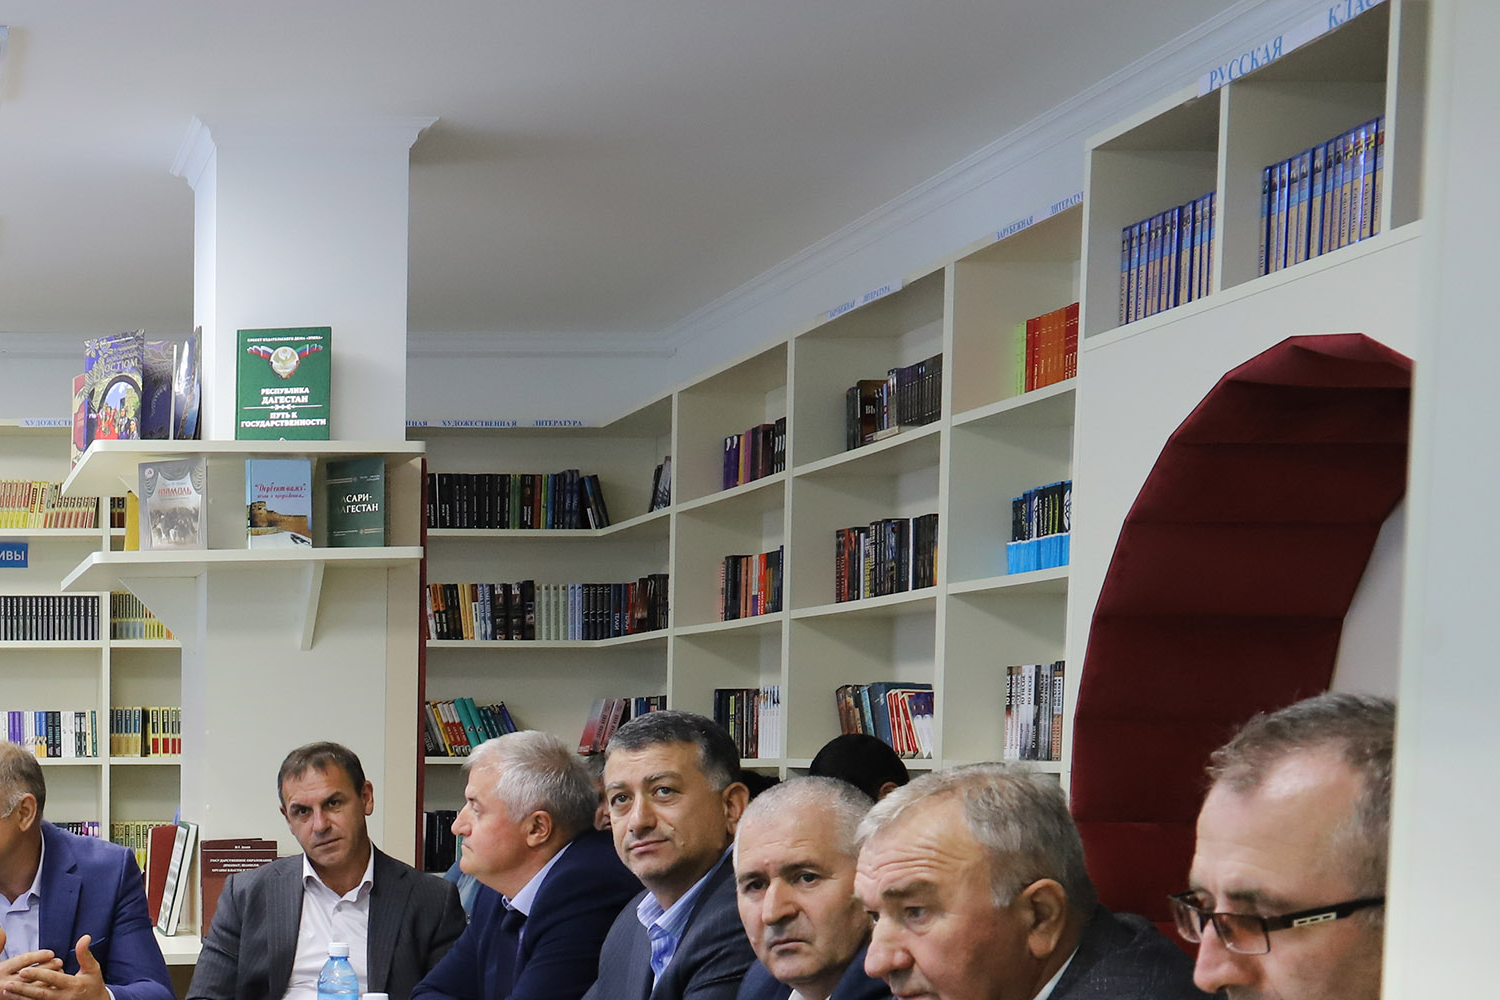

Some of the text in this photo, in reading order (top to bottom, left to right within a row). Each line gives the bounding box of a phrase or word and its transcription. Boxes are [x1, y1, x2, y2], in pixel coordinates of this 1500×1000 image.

[1209, 35, 1283, 92] РУССКАЯ
[996, 215, 1034, 240] ЗАРУБЕЖНАЯ
[101, 357, 139, 374] ОСТЮМ
[260, 387, 310, 396] РЕСПУБЛИКА
[261, 395, 309, 405] ДАГЕСТАН
[269, 411, 298, 420] ПУТЬ К
[240, 418, 327, 428] ГОСУДАРСТВЕННОСТИ
[441, 420, 518, 428] ХУДОЖЕСТВЕННАЯ
[532, 419, 583, 427] ЛИТЕРАТУРА
[339, 502, 379, 514] АГЕСТАН
